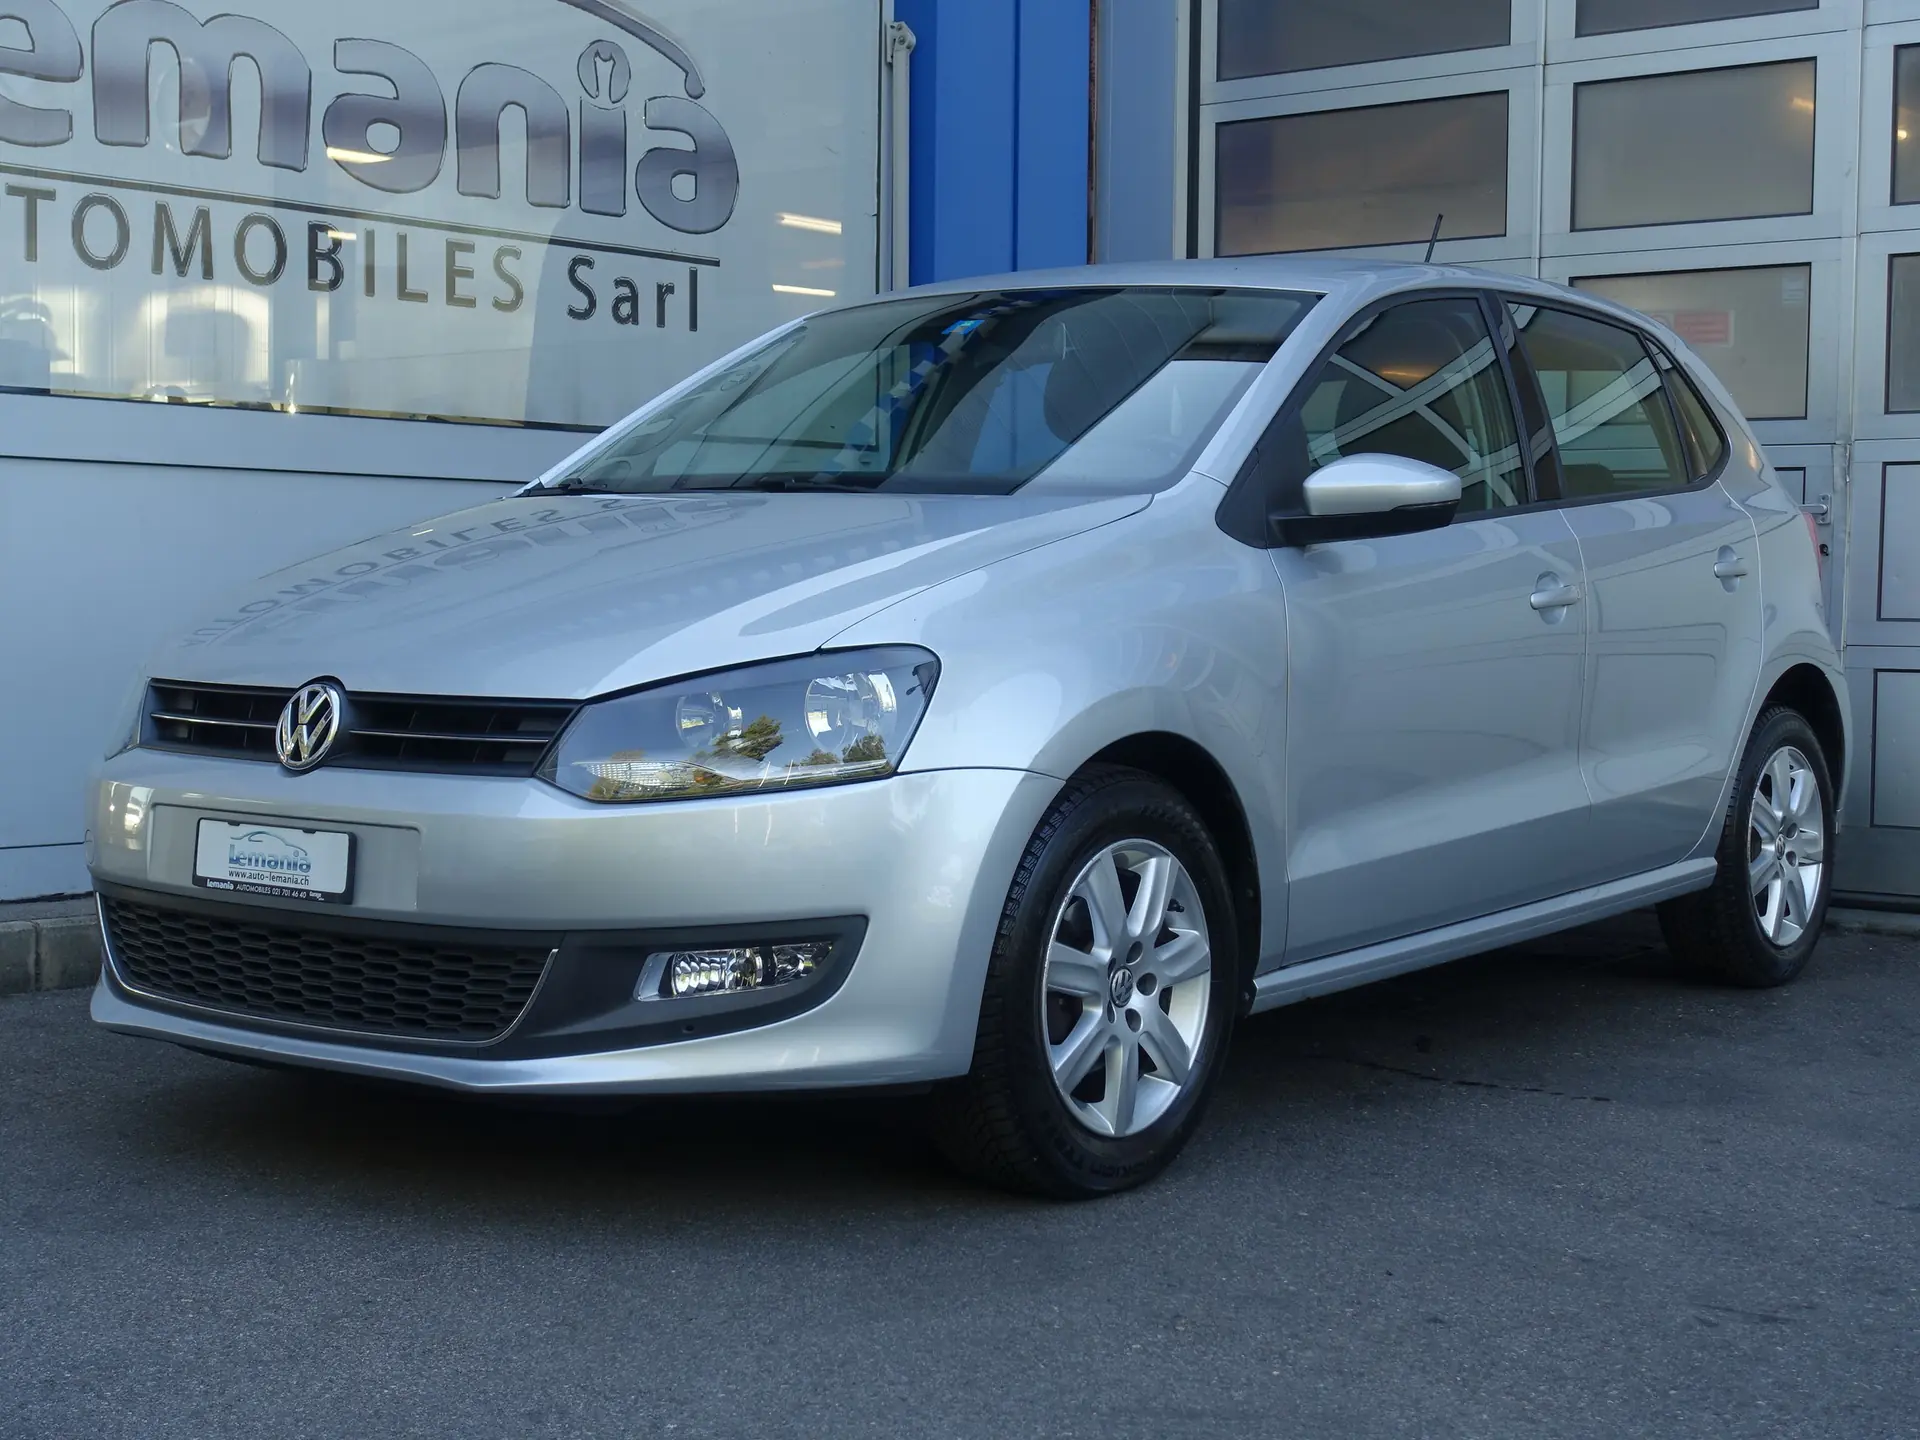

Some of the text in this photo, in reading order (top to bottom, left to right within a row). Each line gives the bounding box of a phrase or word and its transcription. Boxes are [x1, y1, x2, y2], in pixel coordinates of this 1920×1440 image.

[5, 183, 698, 331] TOMOBILES Sarl
[229, 844, 311, 873] Lemania
[229, 870, 309, 886] www.auto-lemania.ch
